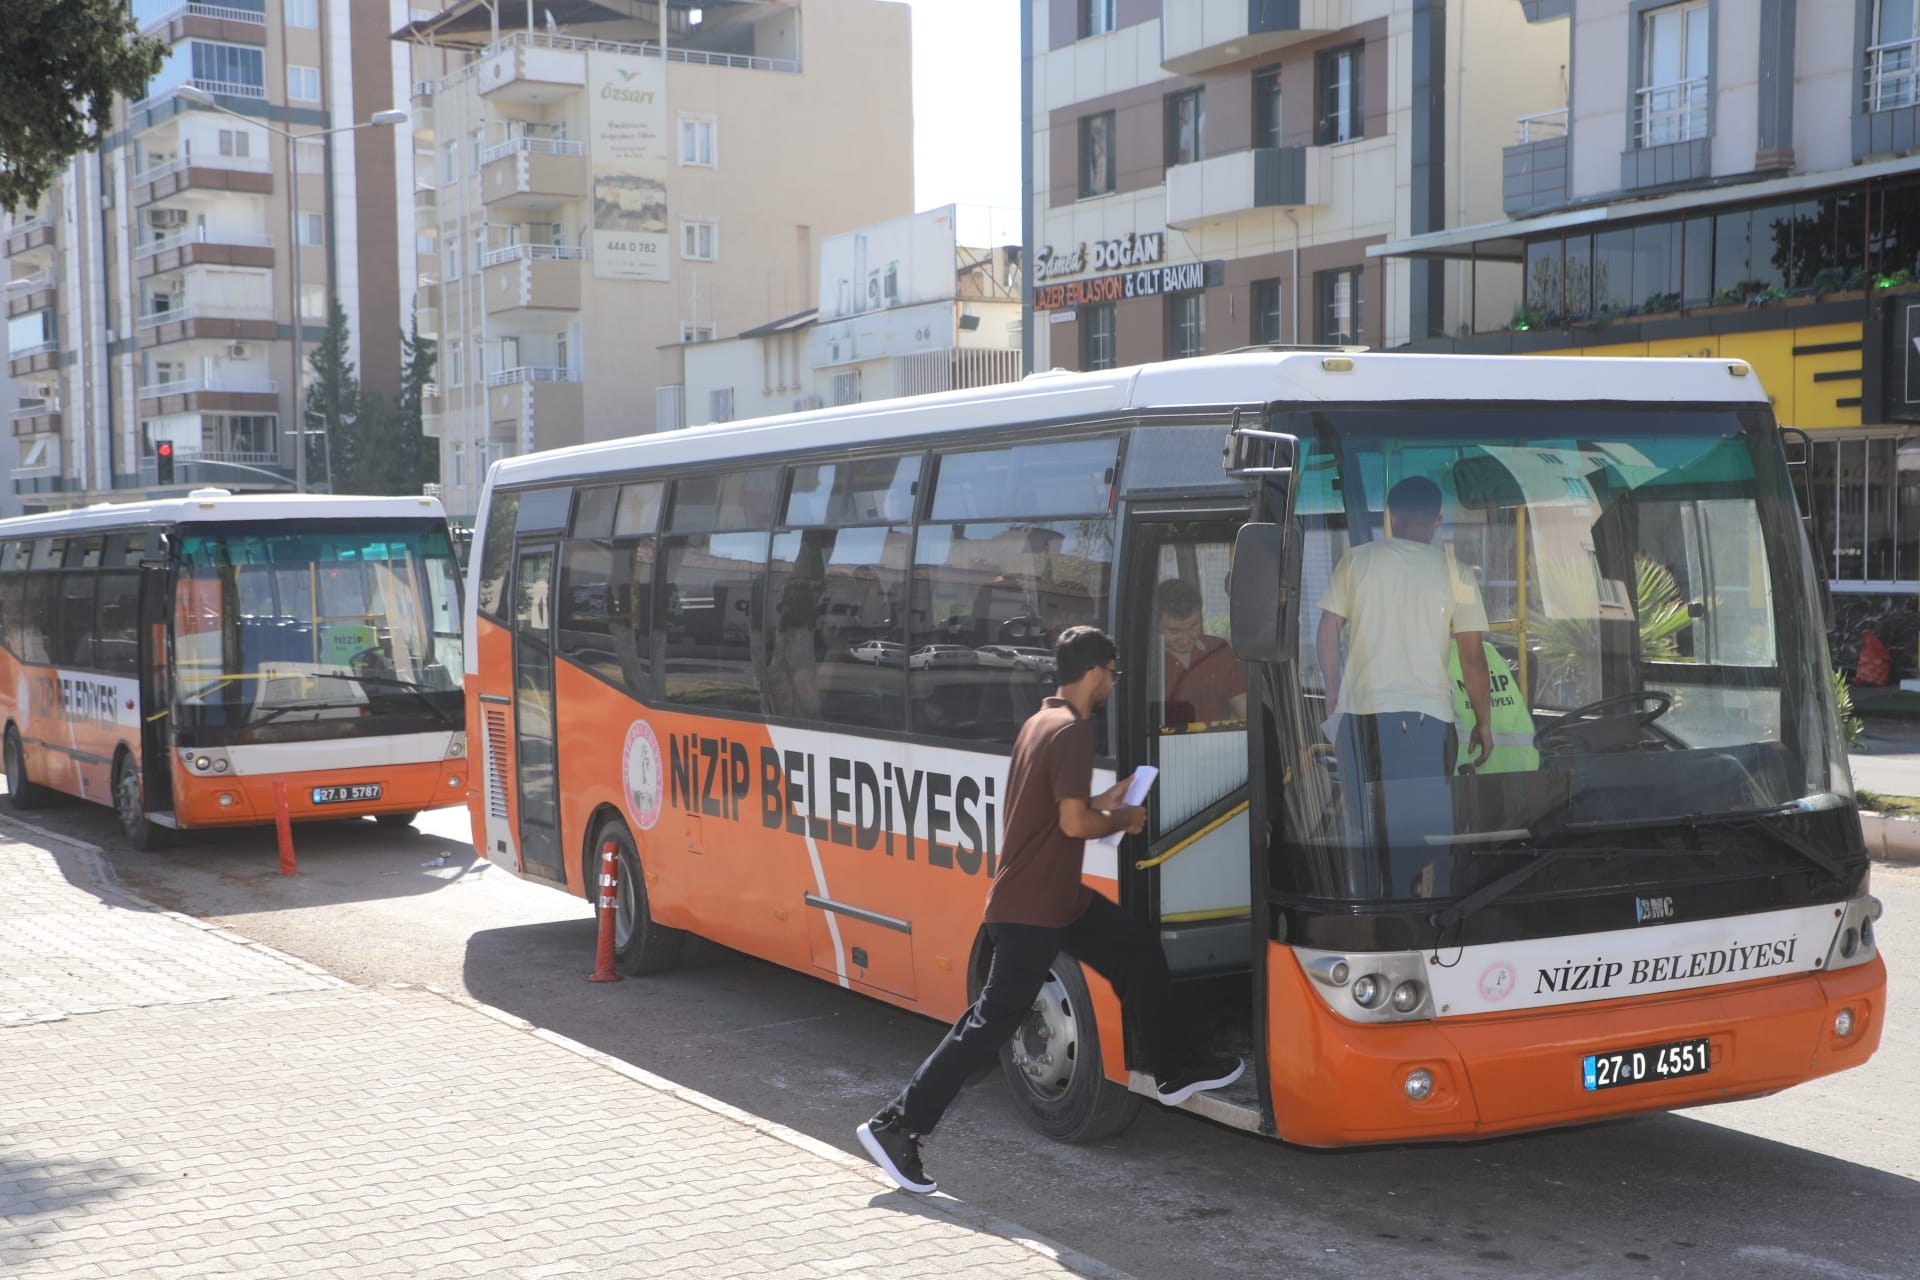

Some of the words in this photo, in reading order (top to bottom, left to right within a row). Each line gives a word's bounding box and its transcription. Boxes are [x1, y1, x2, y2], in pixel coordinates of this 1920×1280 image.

[608, 240, 626, 251] 444
[1093, 232, 1163, 270] DOĞAN
[1033, 285, 1065, 311] LAZER
[1125, 274, 1135, 298] &
[1163, 263, 1204, 293] BAKIMI
[352, 785, 379, 798] 5787
[1639, 896, 1674, 920] BMC
[1533, 956, 1623, 995] NİZİP
[1630, 932, 1799, 986] BELEDİYESİ
[1597, 1055, 1624, 1086] 27
[1632, 1052, 1646, 1080] D
[1656, 1043, 1707, 1075] 4551
